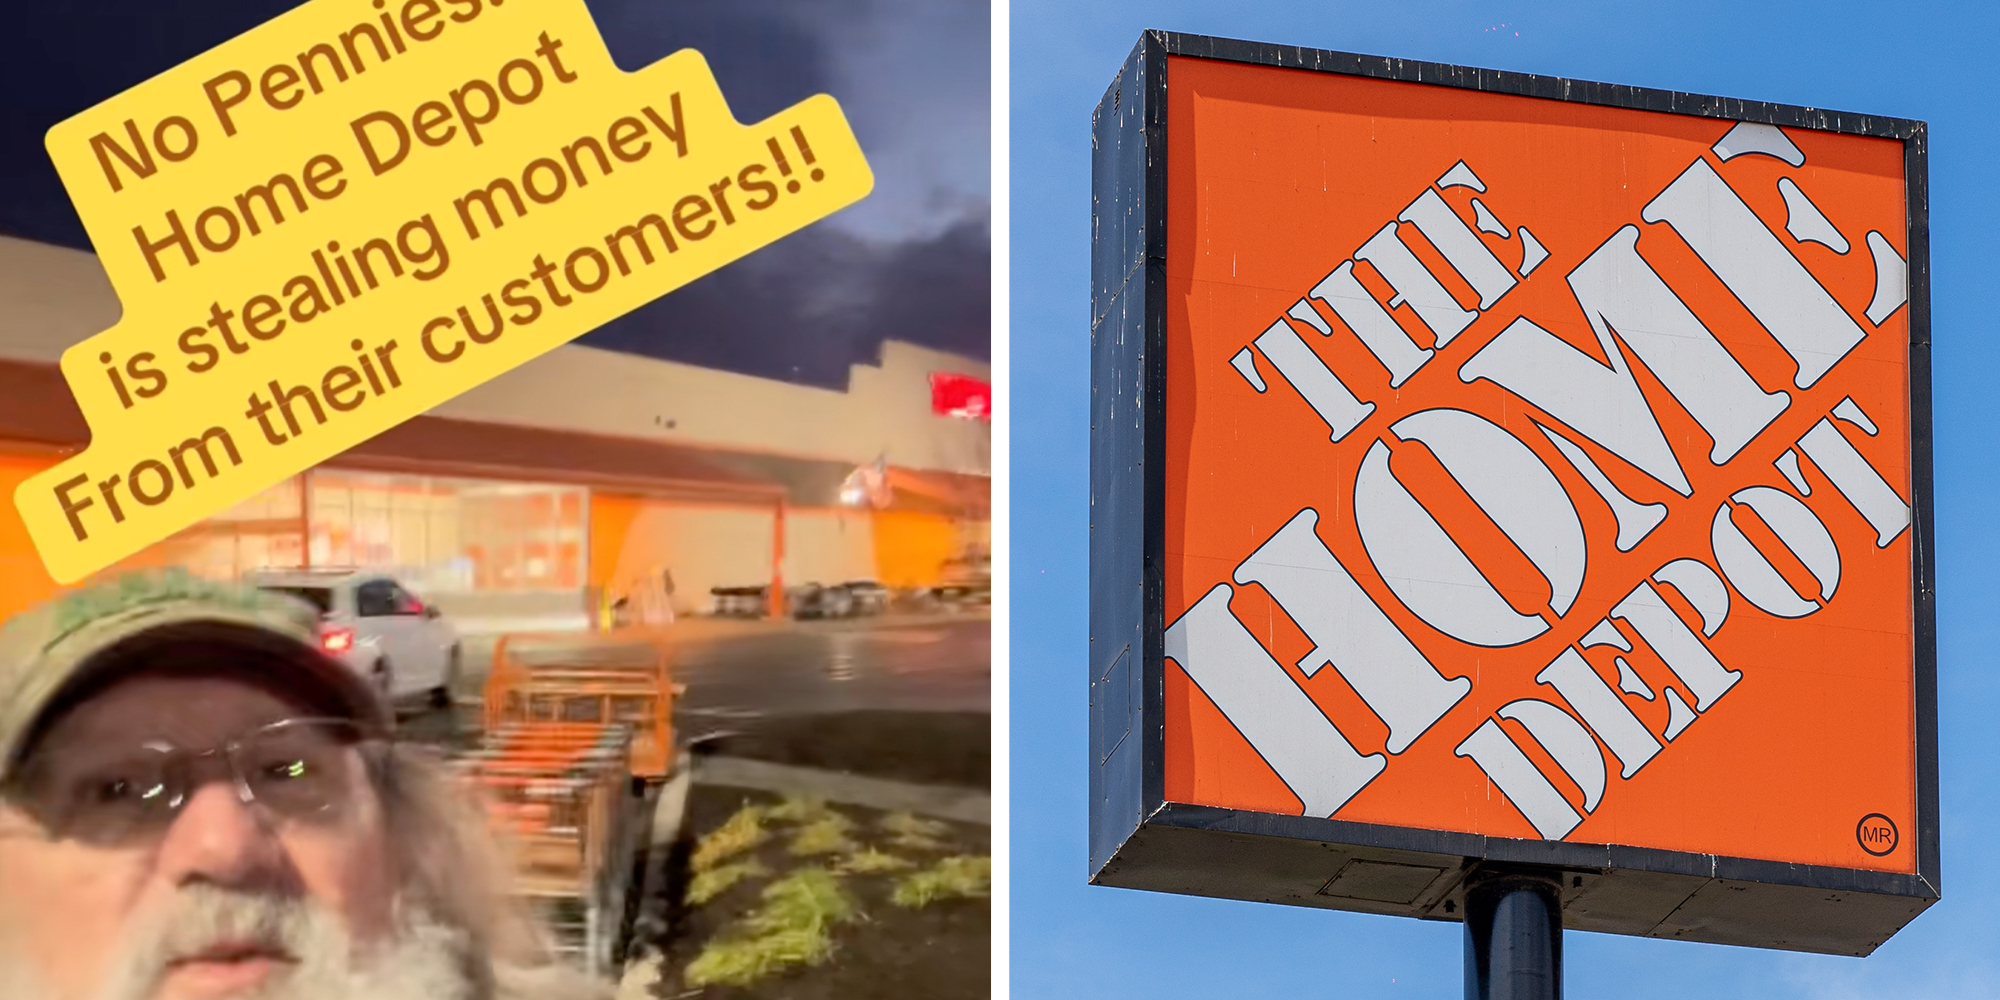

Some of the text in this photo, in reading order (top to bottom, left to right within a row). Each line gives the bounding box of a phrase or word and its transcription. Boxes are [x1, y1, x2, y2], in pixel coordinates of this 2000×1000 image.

[1167, 121, 1908, 820] HOME
[1230, 160, 1551, 443] THE
[1454, 396, 1909, 842] DEPOT
[1863, 826, 1892, 844] MR
